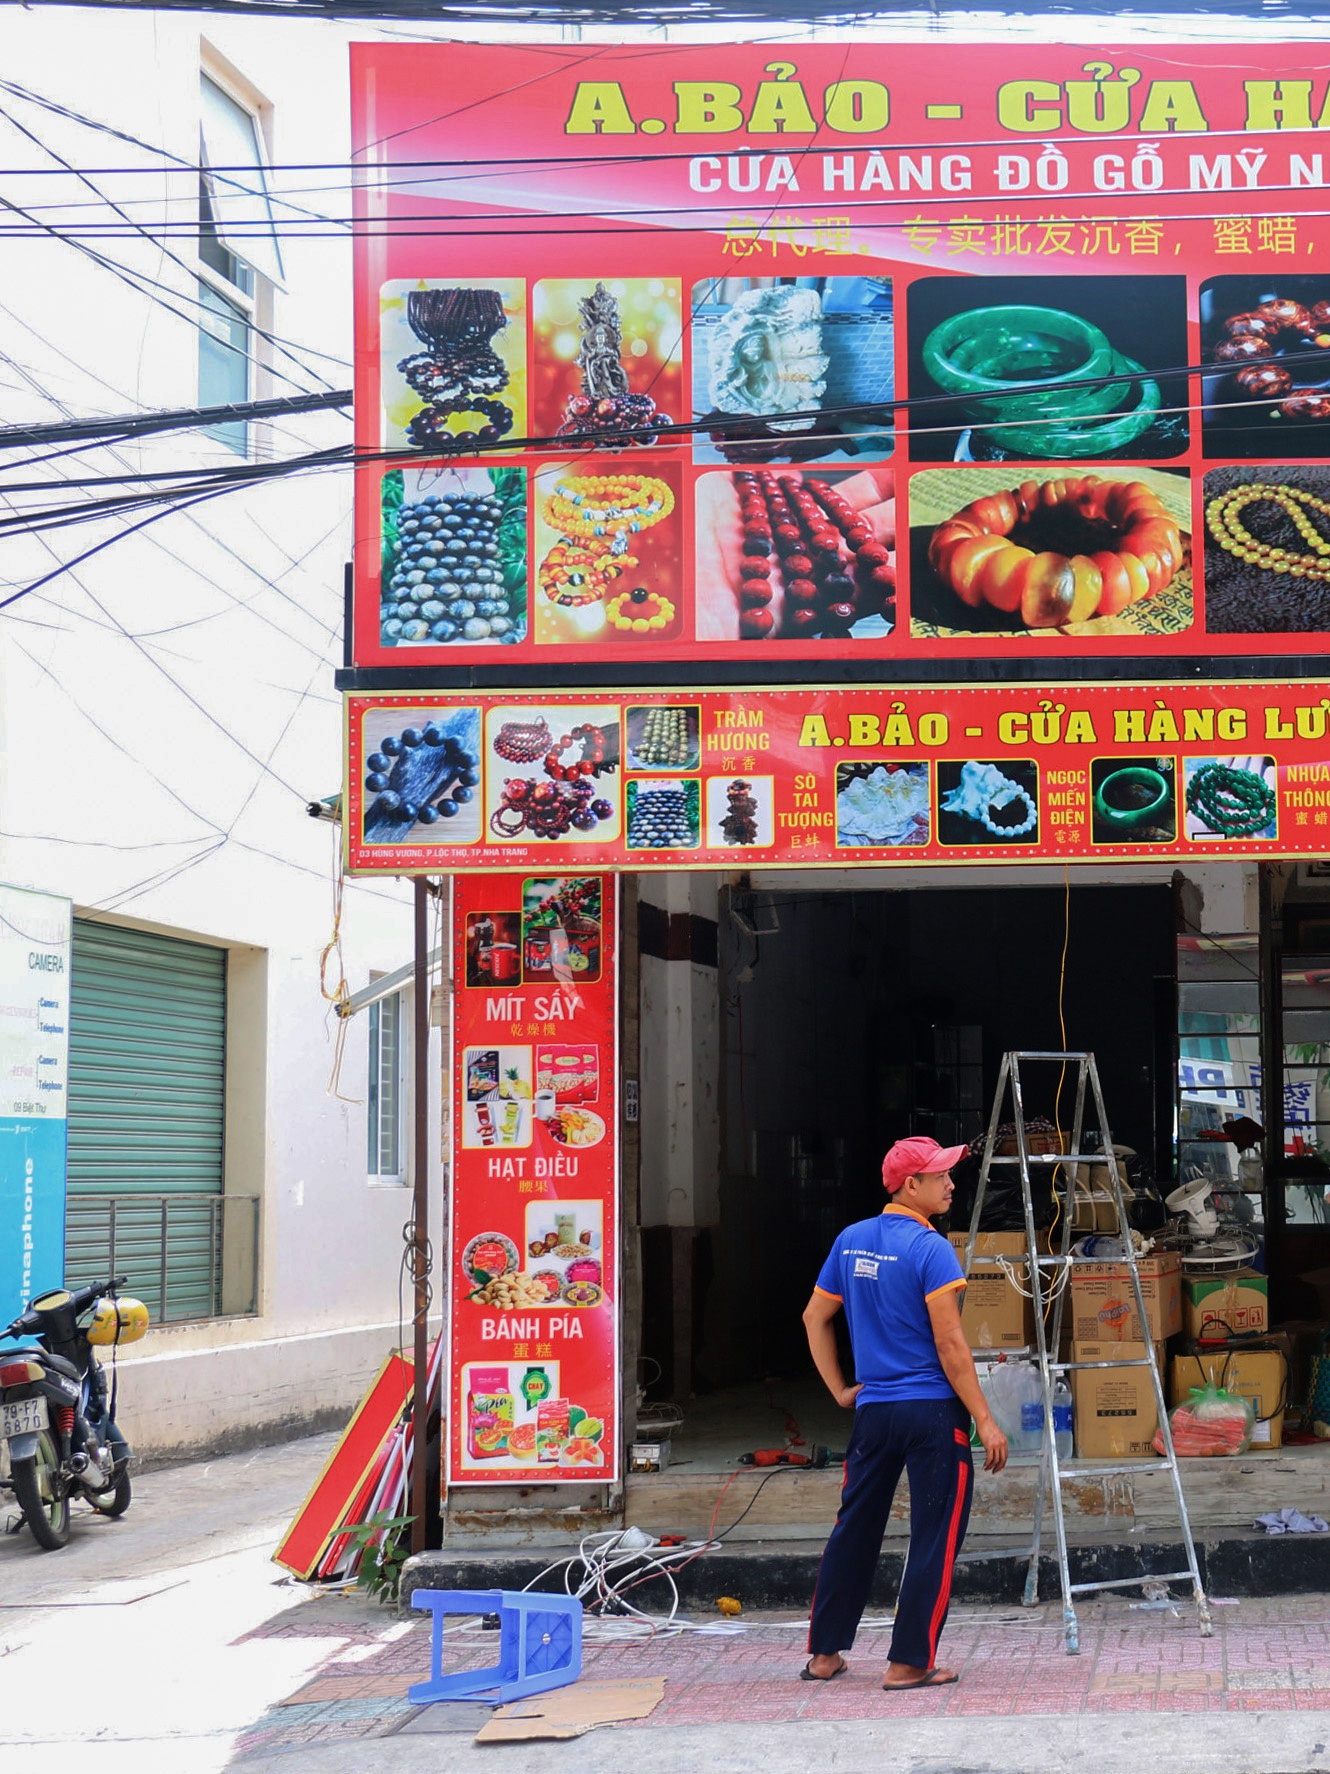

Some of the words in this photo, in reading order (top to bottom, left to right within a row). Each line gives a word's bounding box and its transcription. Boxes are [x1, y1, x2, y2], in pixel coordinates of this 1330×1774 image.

[565, 61, 890, 135] A.BẢO
[995, 60, 1207, 134] CỬA
[688, 146, 800, 194] CỬA
[823, 149, 973, 193] HÀNG
[993, 143, 1069, 192] ĐỒ
[1093, 142, 1164, 192] GỖ
[1189, 146, 1269, 191] MỸ
[713, 704, 764, 728] TRẦM
[798, 701, 949, 747] A.BẢO
[998, 700, 1097, 745] CỬA
[1113, 700, 1247, 742] HÀNG
[707, 730, 770, 751] HƯƠNG
[721, 755, 757, 771] 沉香
[794, 772, 817, 790] SÒ
[1046, 770, 1086, 787] NGỌC
[1286, 765, 1330, 783] NHỰA
[793, 793, 819, 808] TAI
[1047, 787, 1086, 807] MIẾN
[778, 811, 834, 831] TƯỢNG
[1050, 808, 1085, 828] ĐIỆN
[501, 847, 529, 856] TRANG
[28, 952, 64, 974] CAMERA
[486, 992, 526, 1021] MÍT
[534, 988, 580, 1021] SẤY
[488, 1157, 527, 1182] HẠT
[535, 1149, 579, 1177] ĐIỀU
[518, 1180, 549, 1193] 腰果
[481, 1314, 540, 1340] BÁNH
[549, 1312, 584, 1339] PÍA
[513, 1343, 552, 1358] 蛋糕
